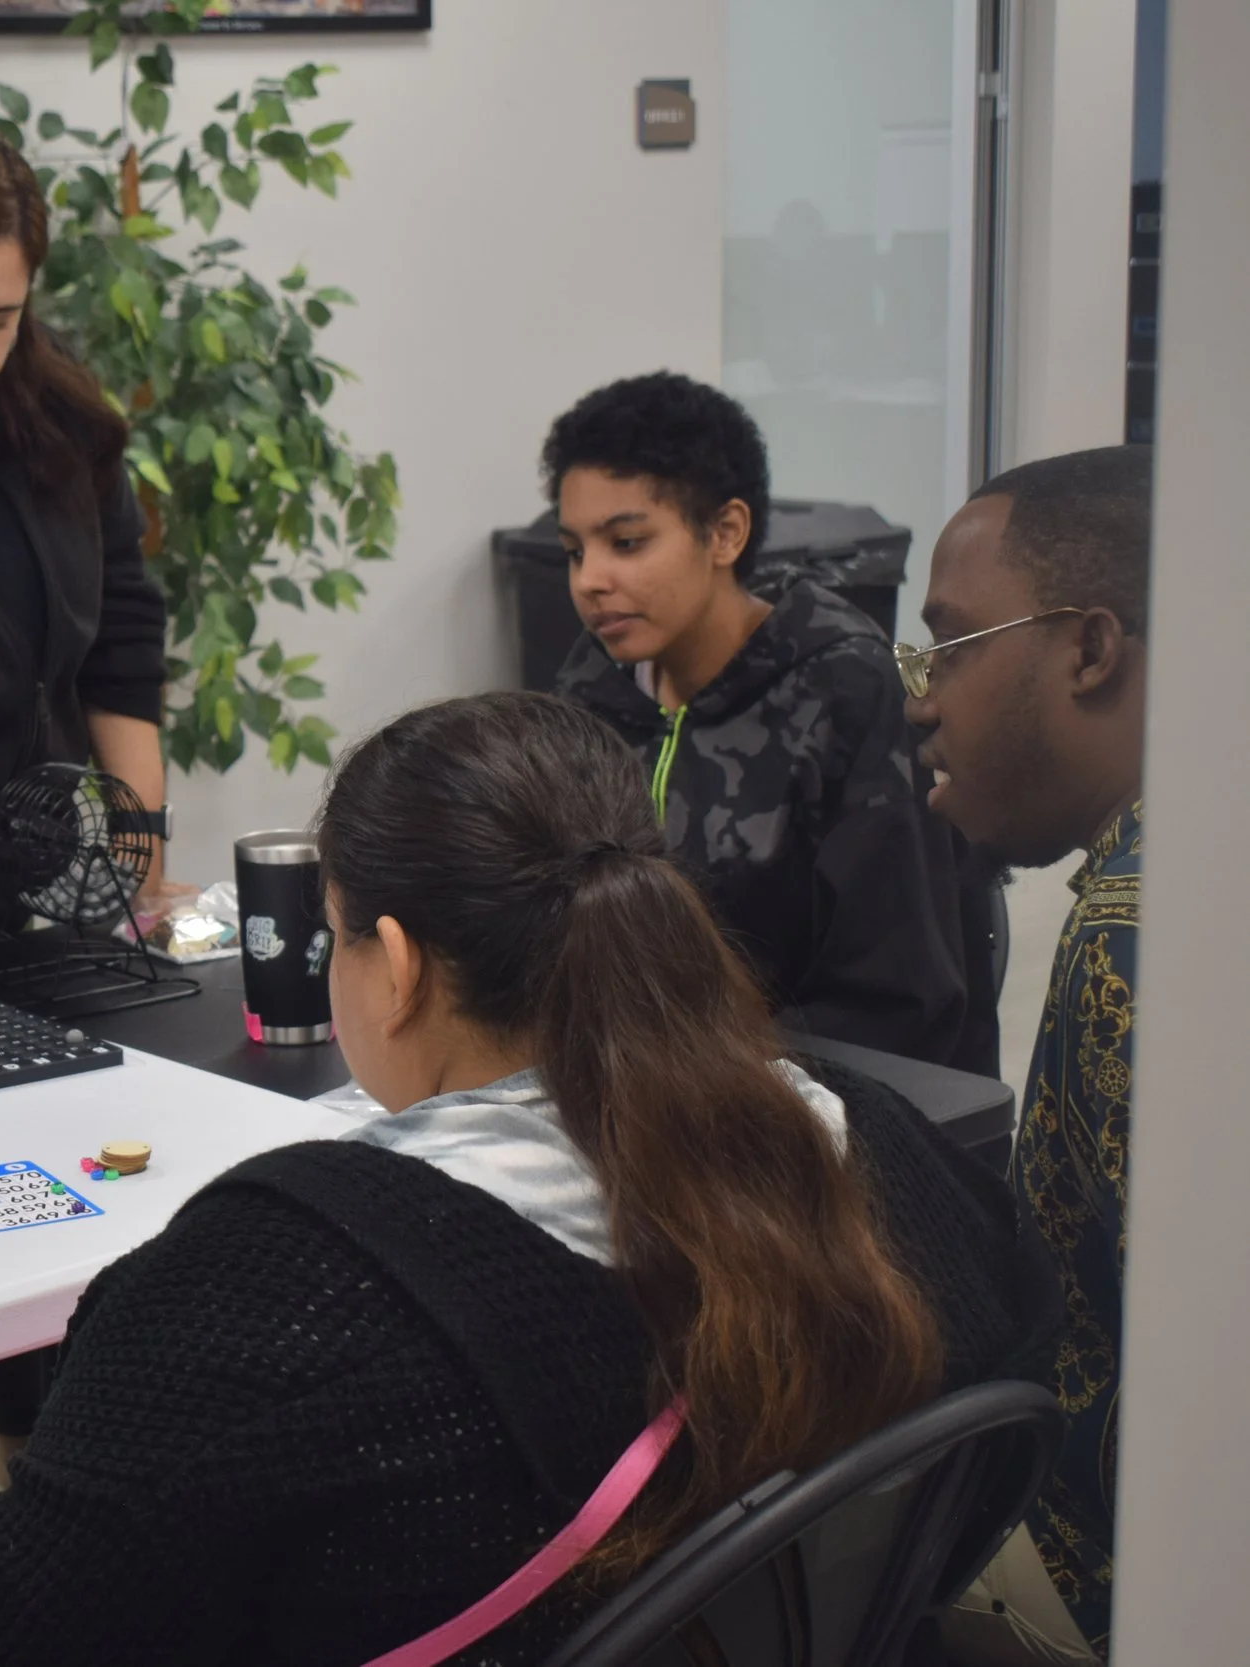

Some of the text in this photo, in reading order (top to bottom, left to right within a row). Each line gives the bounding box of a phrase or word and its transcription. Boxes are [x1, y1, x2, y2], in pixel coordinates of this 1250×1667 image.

[13, 1171, 42, 1180] 70
[28, 1180, 51, 1189] 62
[11, 1194, 37, 1203] 60
[22, 1203, 46, 1212] 59
[2, 1217, 31, 1226] 36
[35, 1211, 59, 1221] 49
